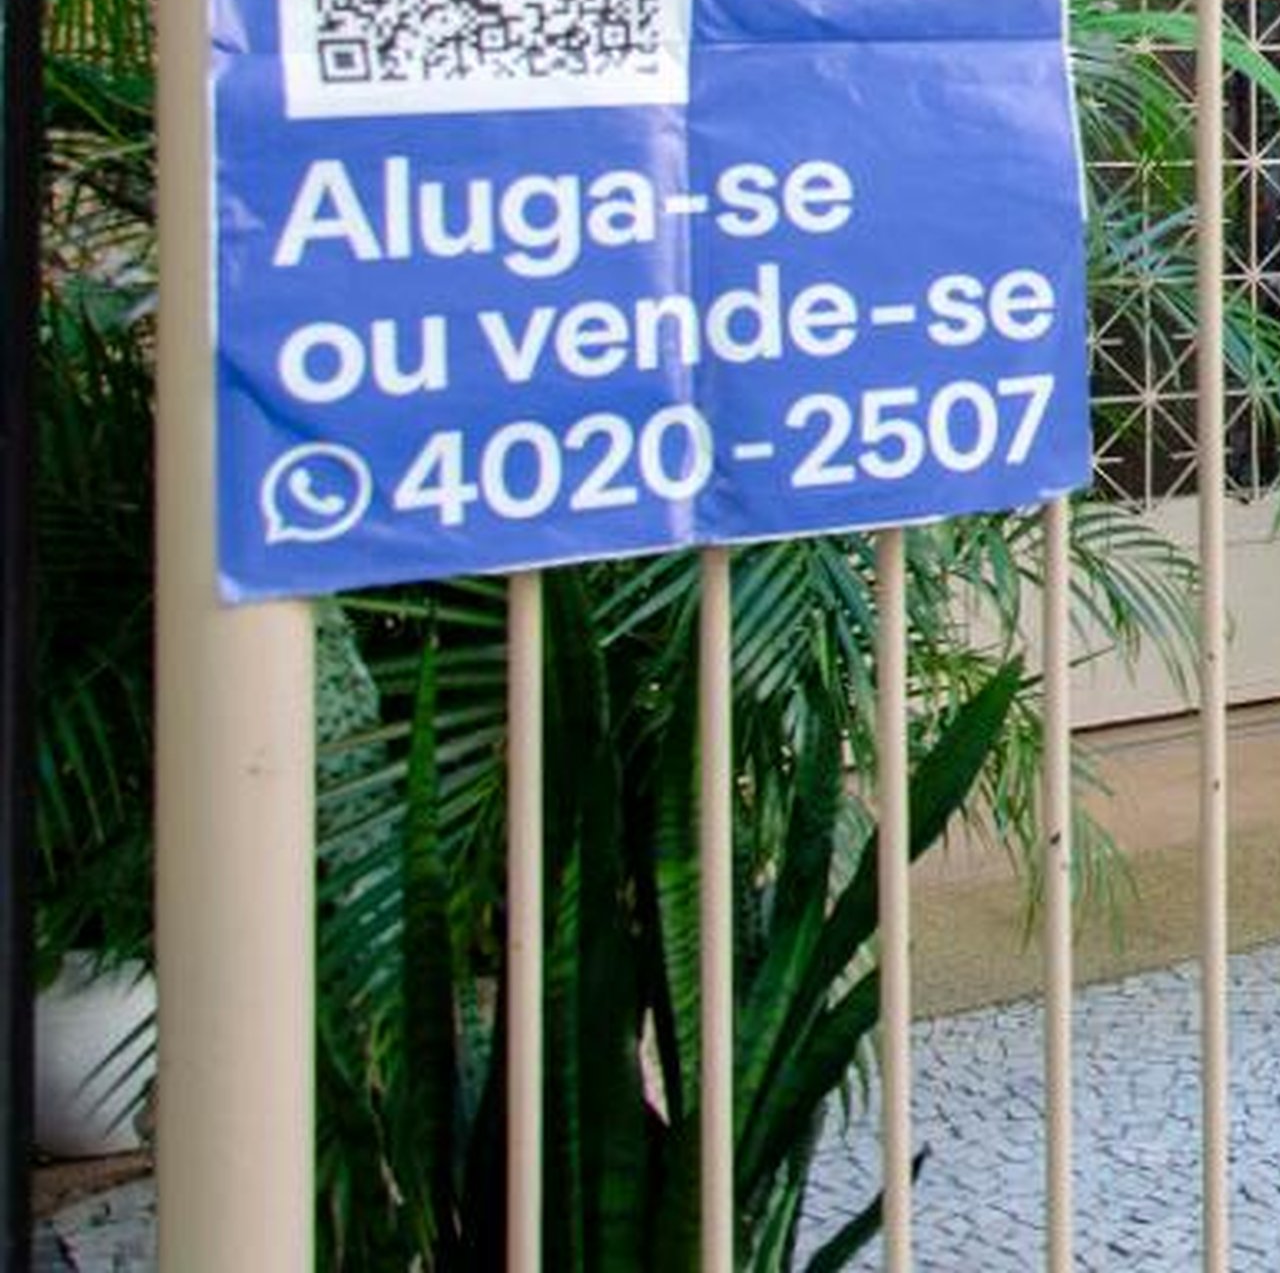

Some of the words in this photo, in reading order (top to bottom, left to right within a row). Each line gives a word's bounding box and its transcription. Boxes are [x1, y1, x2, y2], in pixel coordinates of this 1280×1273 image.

[274, 156, 854, 278] Aluga-se
[277, 314, 450, 404] ou
[480, 264, 1057, 384] vende-se
[394, 374, 1057, 526] 4020-2507
